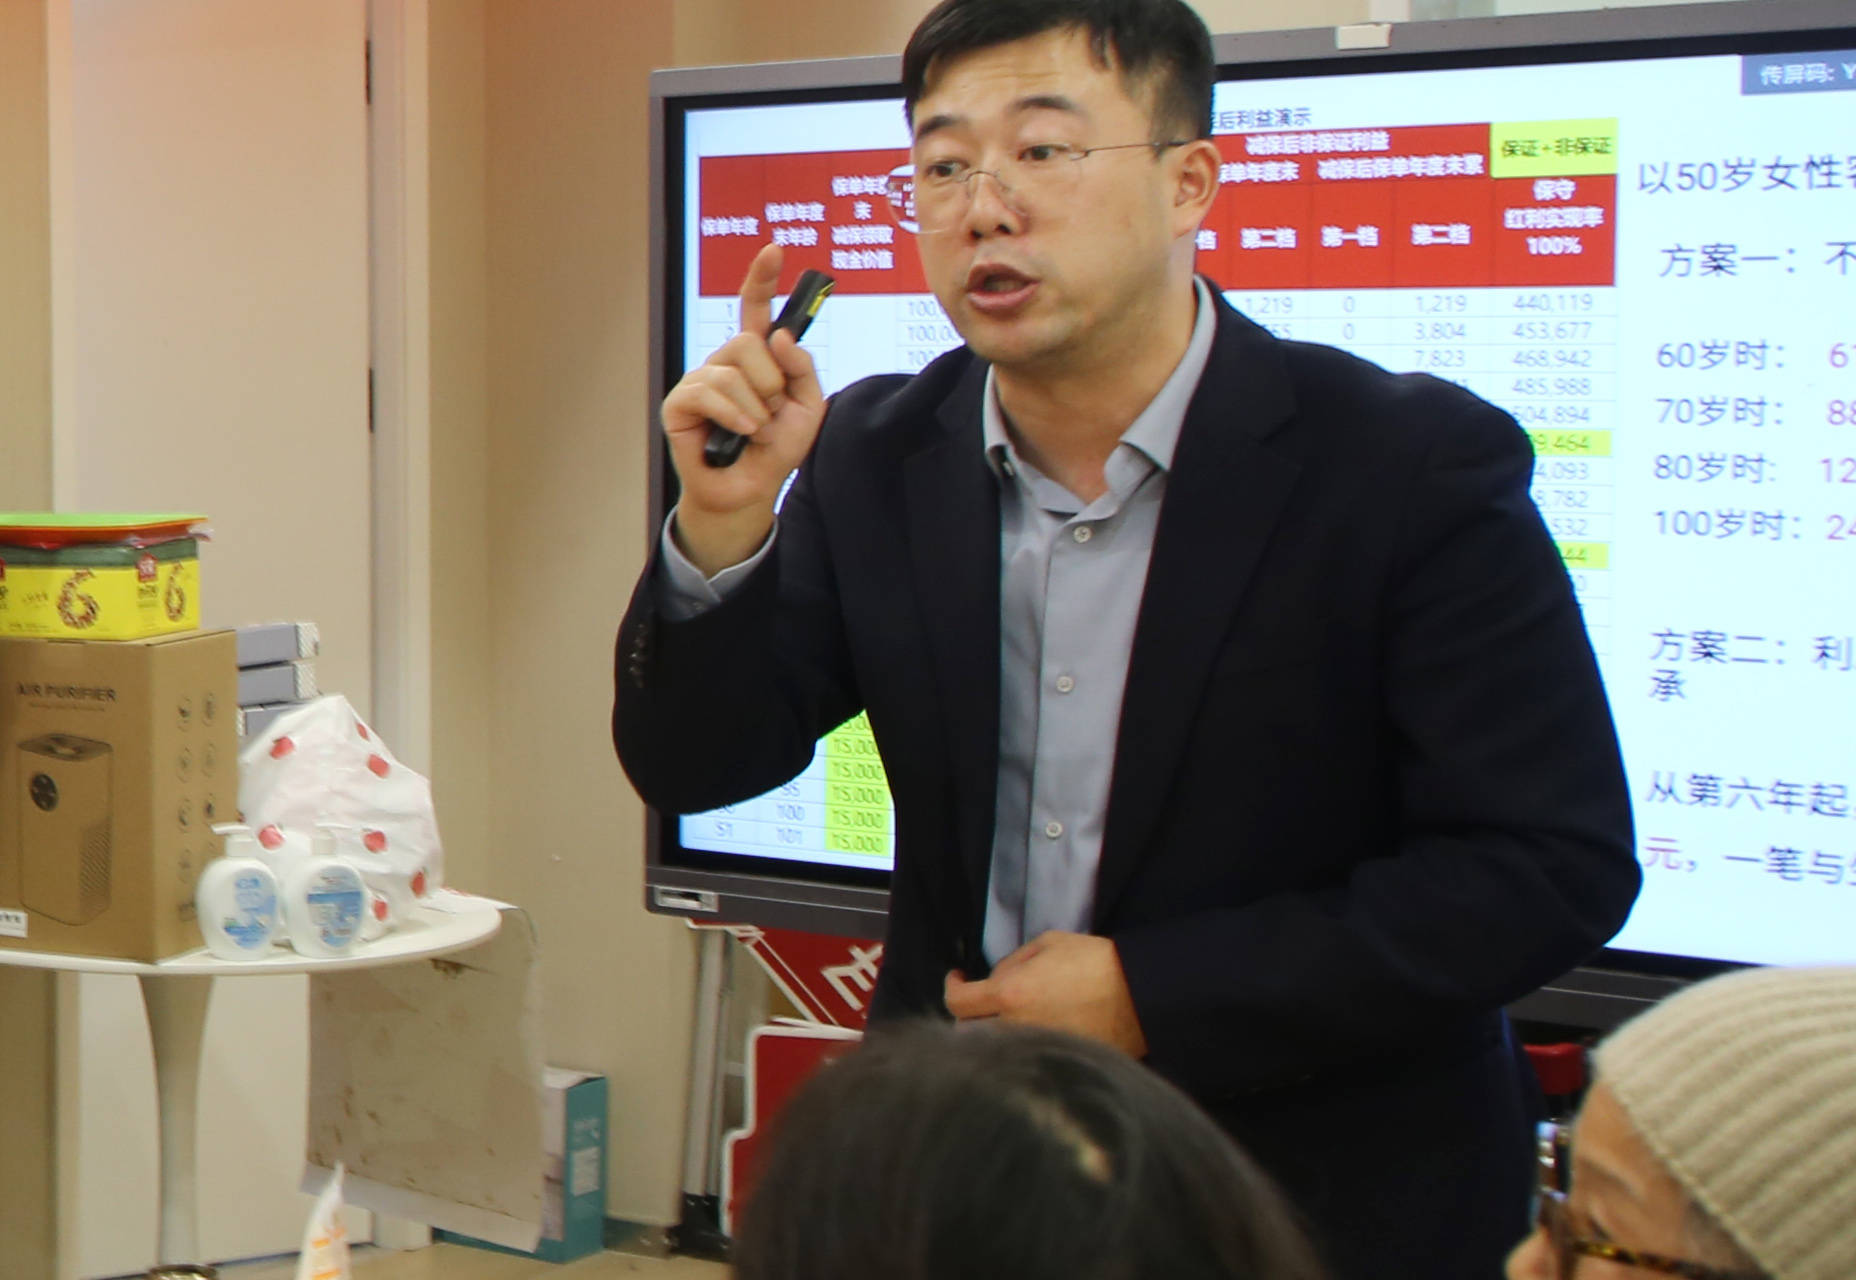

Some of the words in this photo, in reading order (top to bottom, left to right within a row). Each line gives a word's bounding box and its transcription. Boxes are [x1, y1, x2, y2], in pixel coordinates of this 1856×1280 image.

[1212, 107, 1312, 130] 后利益演示
[1532, 178, 1576, 201] 保守
[764, 202, 826, 223] 保单年度
[700, 216, 760, 237] 保单年度
[1240, 228, 1297, 250] 第二档
[1320, 225, 1379, 249] 第一档
[1411, 223, 1471, 247] 第二档
[1525, 235, 1583, 255] 100%
[17, 681, 42, 697] AIR
[44, 685, 118, 703] PURIFIER
[1649, 669, 1686, 703] 承
